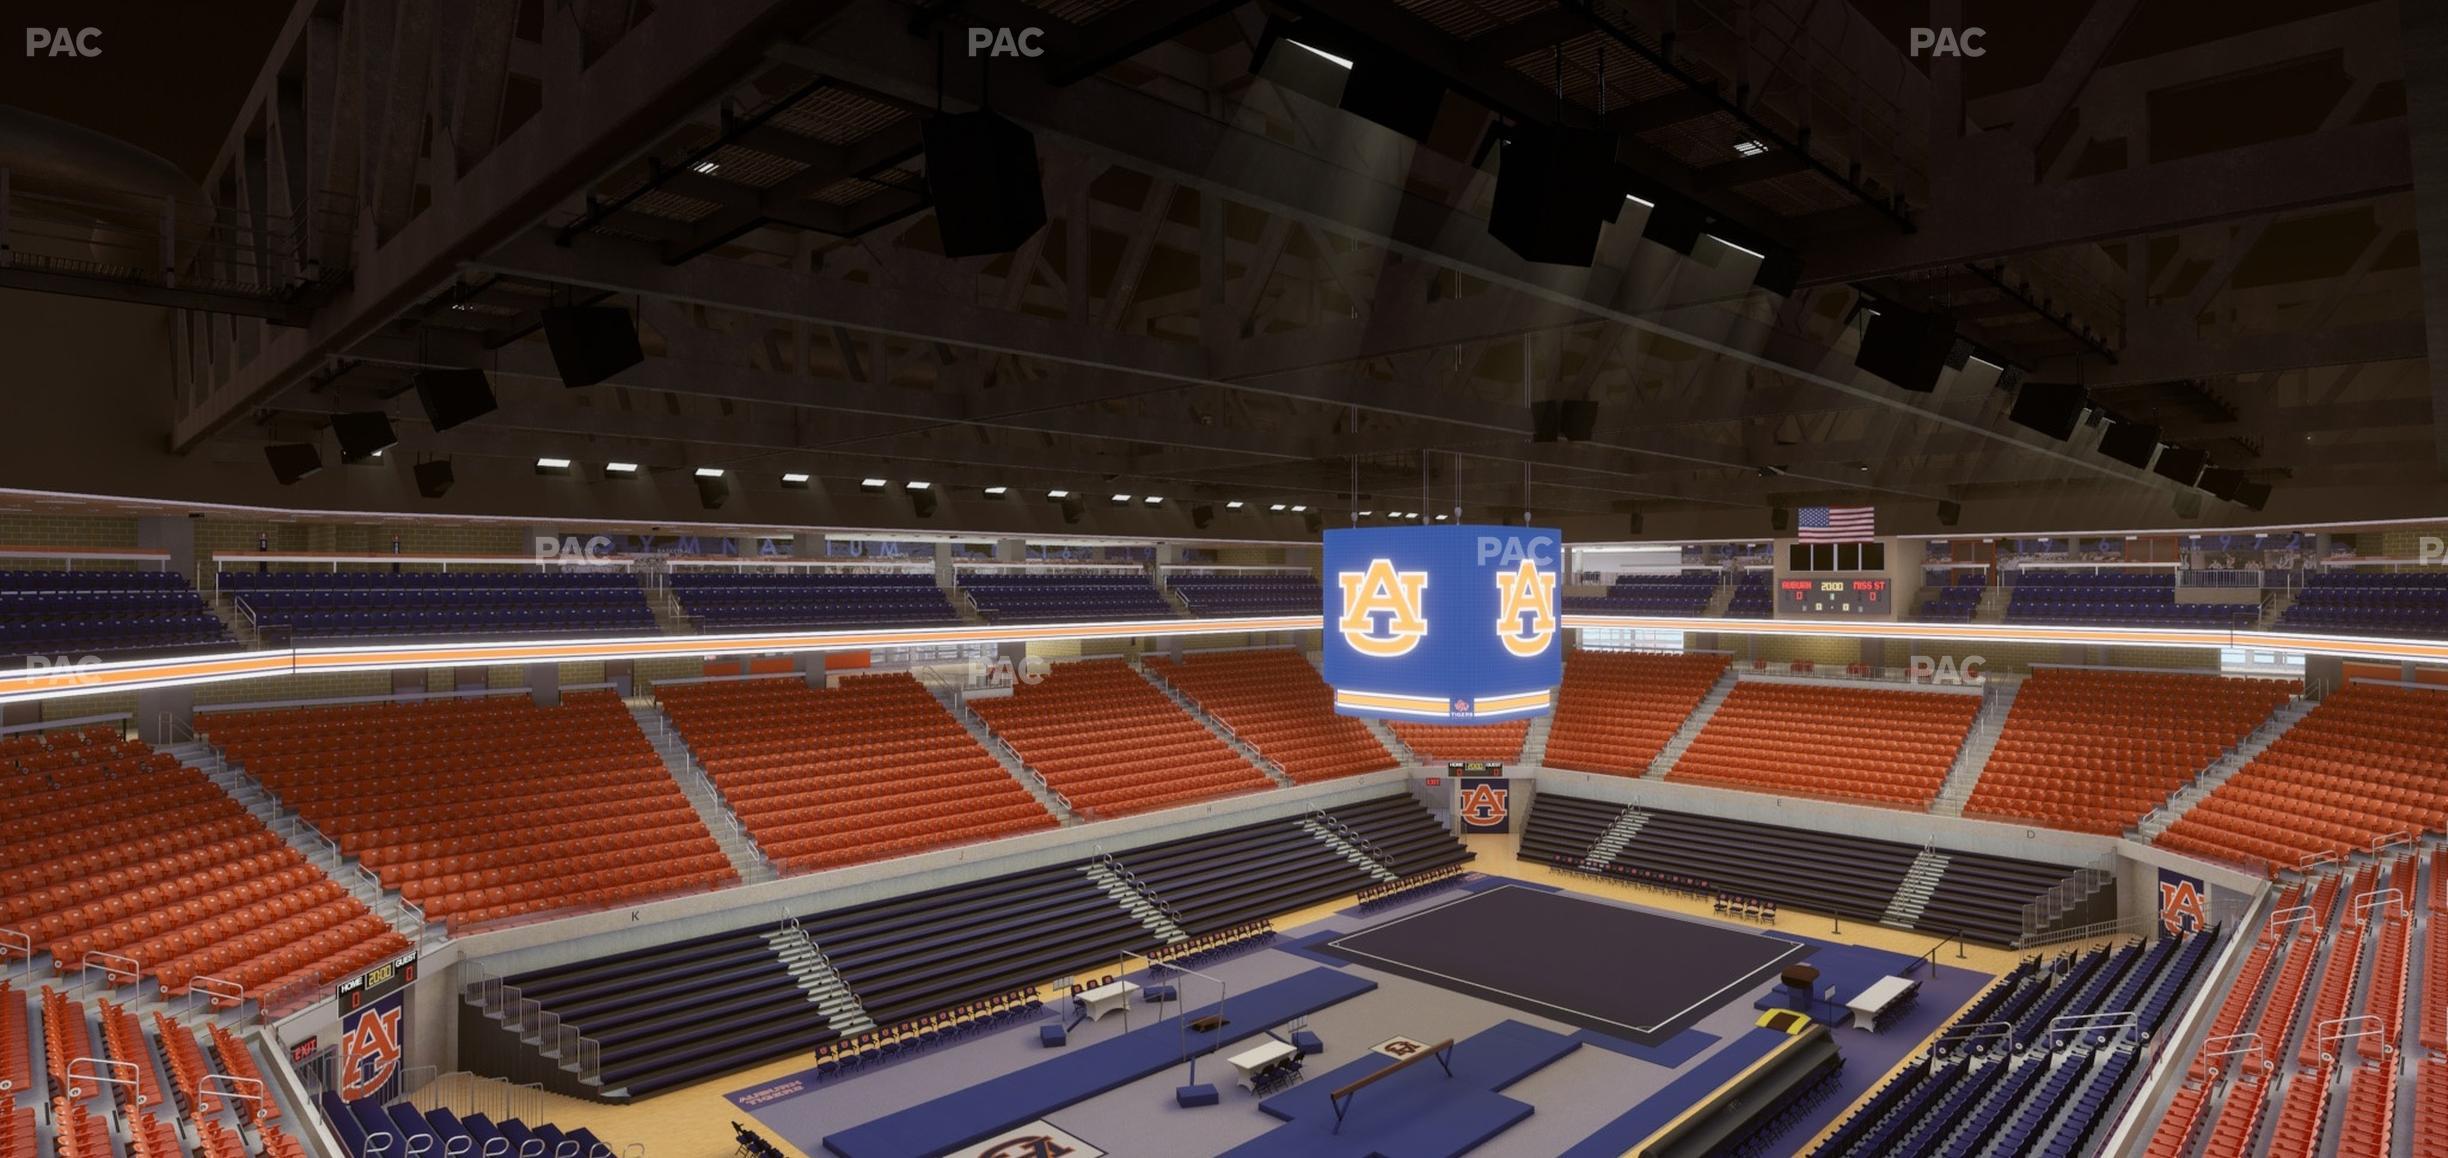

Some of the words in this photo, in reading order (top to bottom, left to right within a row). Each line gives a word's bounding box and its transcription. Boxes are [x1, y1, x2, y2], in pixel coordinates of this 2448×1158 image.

[1796, 591, 1804, 601] 0
[1869, 591, 1877, 601] 0
[2026, 830, 2036, 839] D
[631, 910, 640, 922] K
[395, 952, 417, 968] GUEST
[368, 965, 392, 986] 20:00
[405, 966, 414, 982] 0
[341, 977, 363, 994] HOME
[352, 992, 360, 1008] 0
[294, 1039, 317, 1060] EXIT
